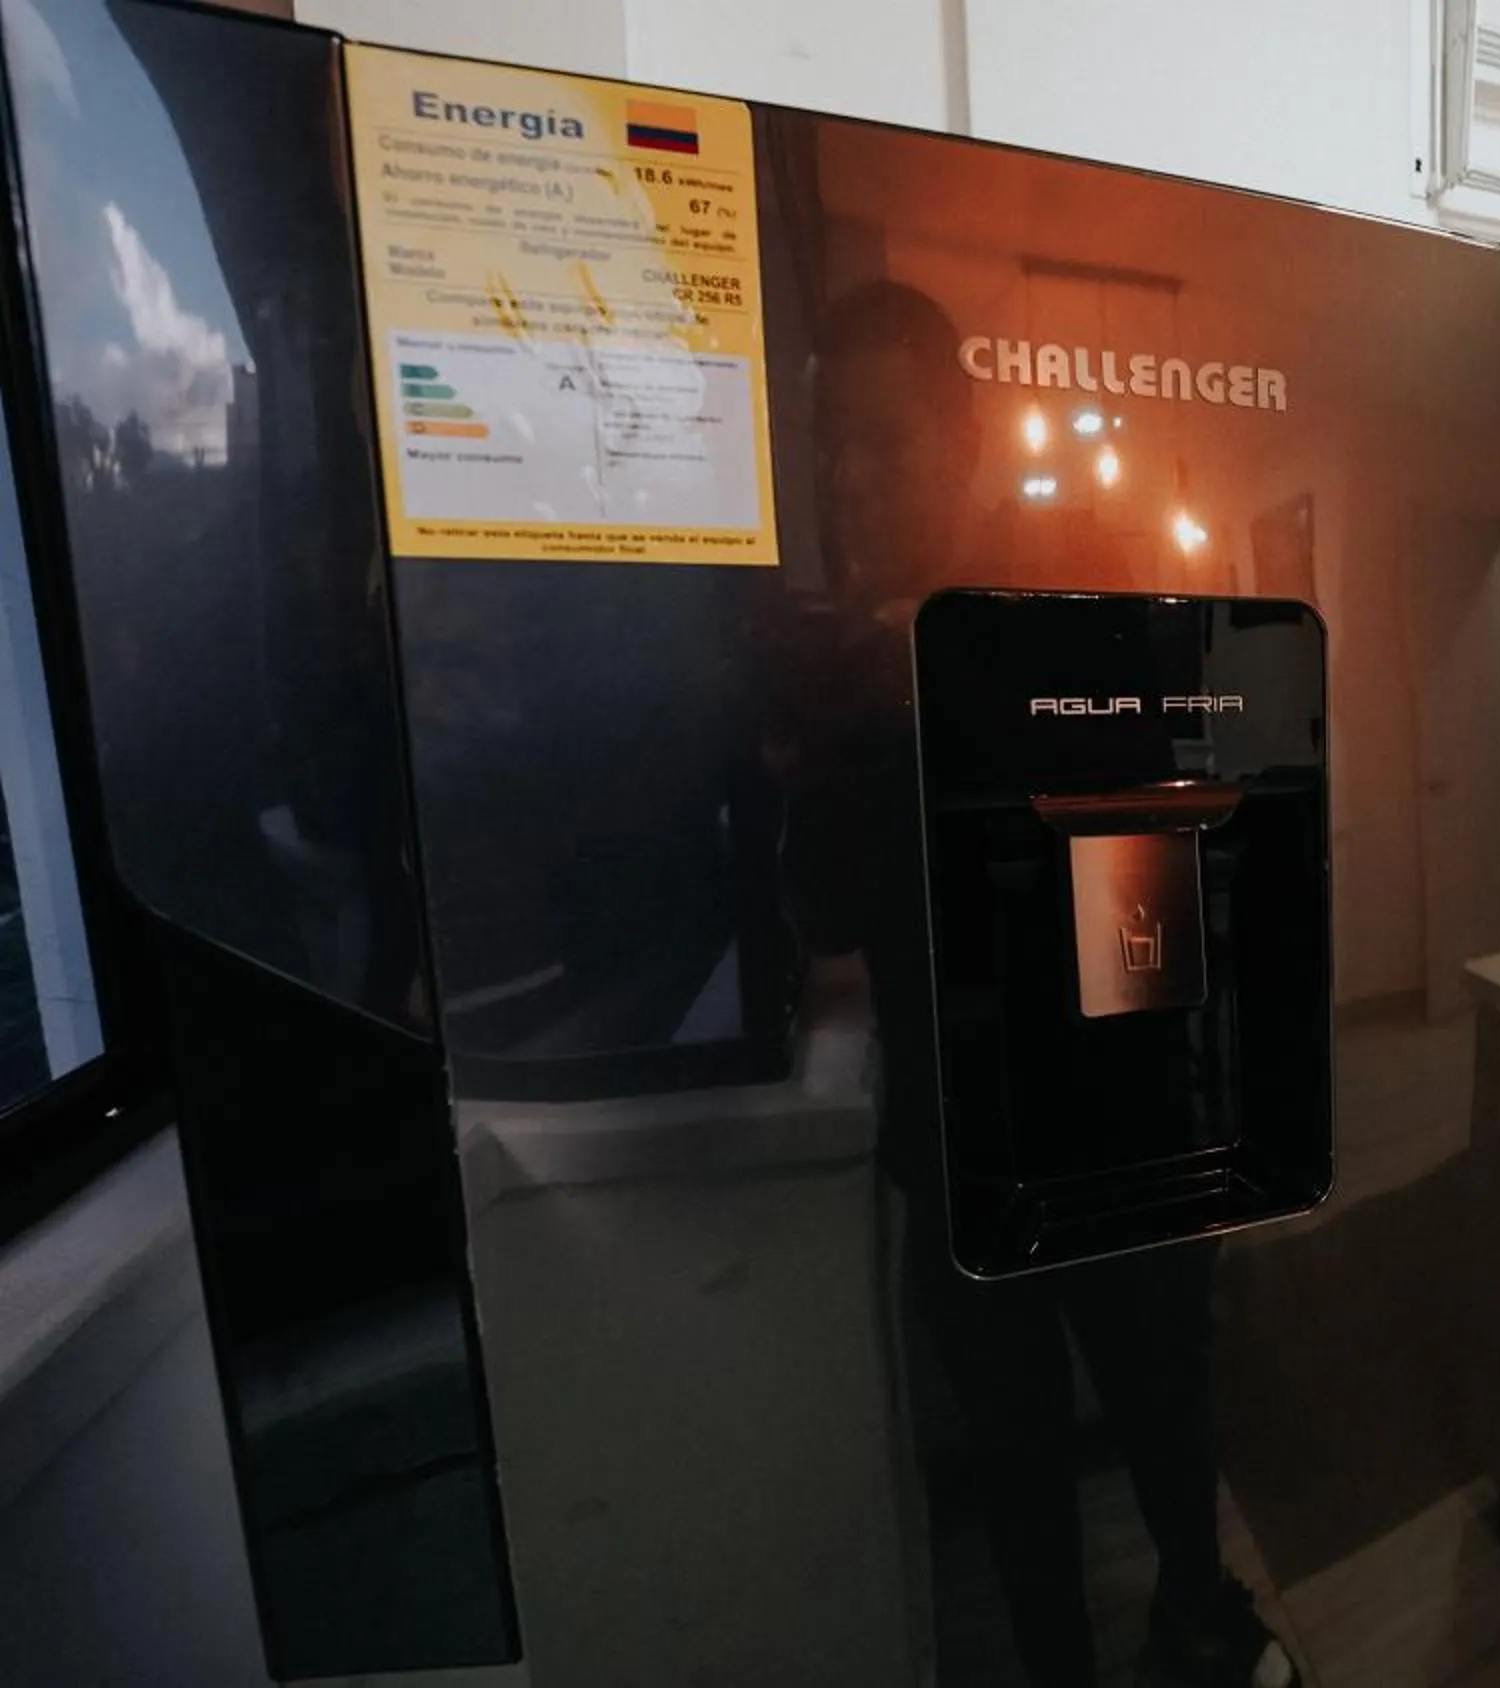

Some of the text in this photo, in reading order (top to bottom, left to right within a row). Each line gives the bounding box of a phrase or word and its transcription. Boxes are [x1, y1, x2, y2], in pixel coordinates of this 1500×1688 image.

[635, 167, 672, 185] 18.6
[689, 198, 711, 215] 67
[641, 267, 741, 291] CHALLENGER
[957, 335, 1288, 413] CHALLENGER
[1029, 694, 1244, 717] AGUA FRIA
